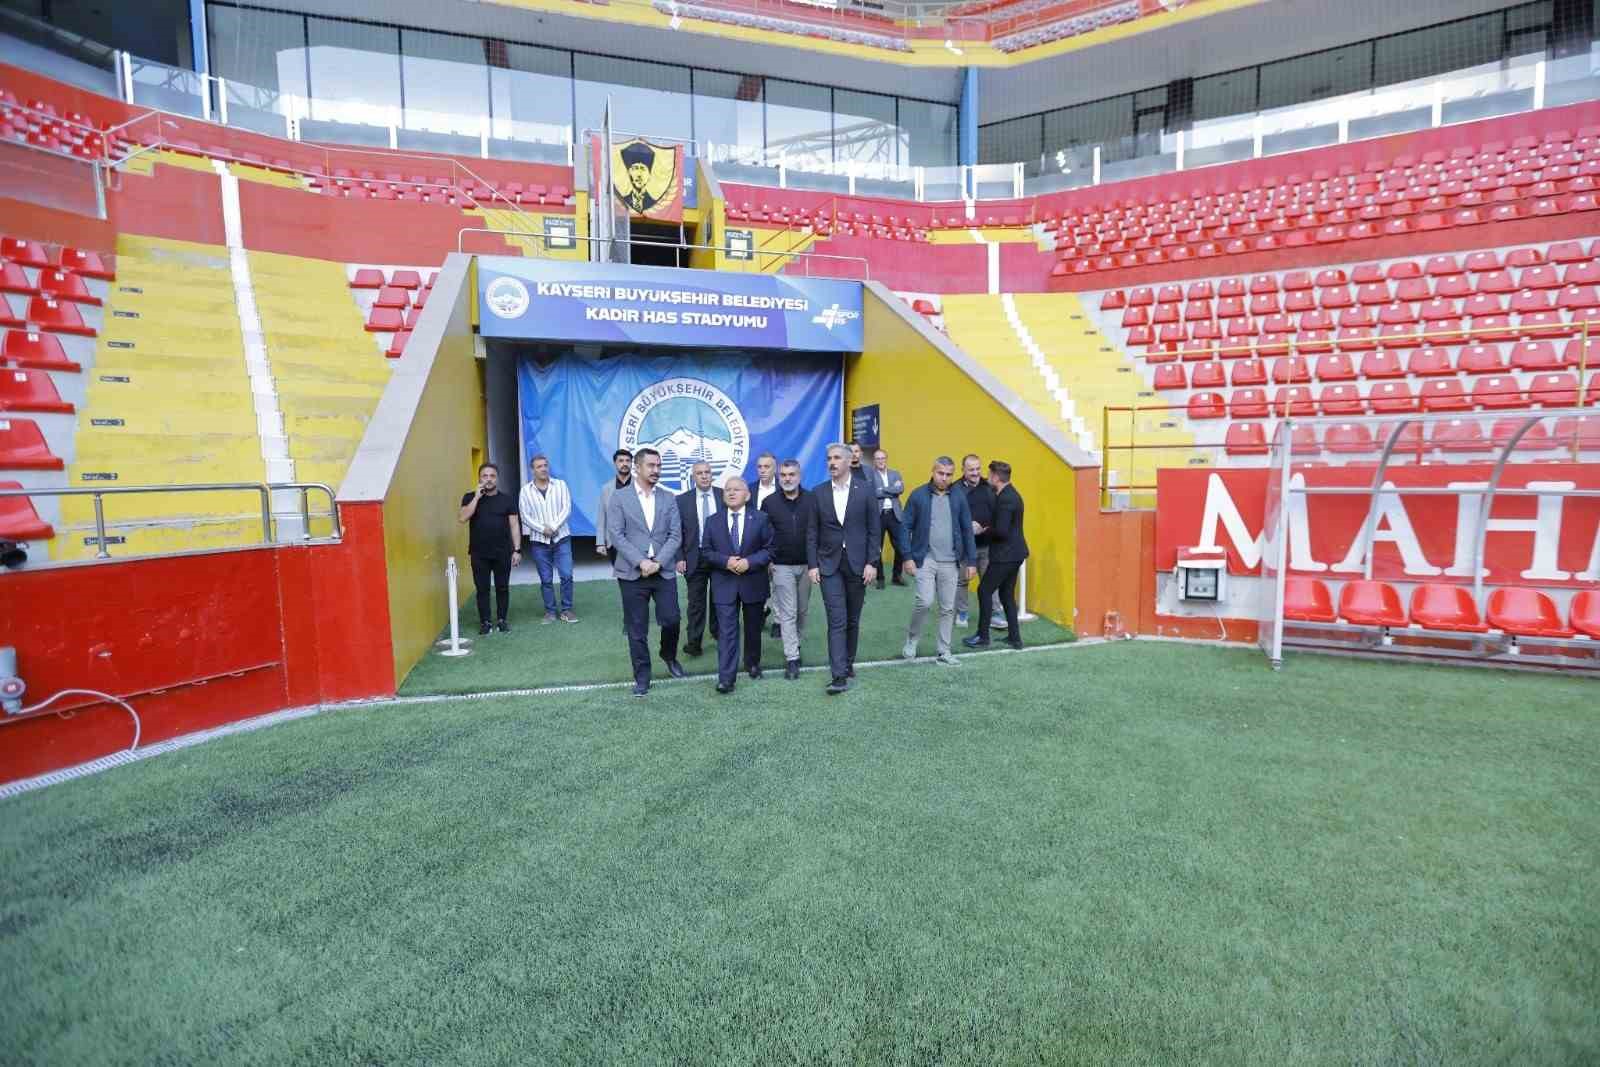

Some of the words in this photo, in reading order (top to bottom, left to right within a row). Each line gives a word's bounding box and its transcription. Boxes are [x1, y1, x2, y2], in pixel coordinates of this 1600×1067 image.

[585, 307, 639, 322] KADİR
[643, 310, 678, 324] HAS
[681, 312, 768, 328] STADYUMU
[1189, 473, 1600, 581] MAH
